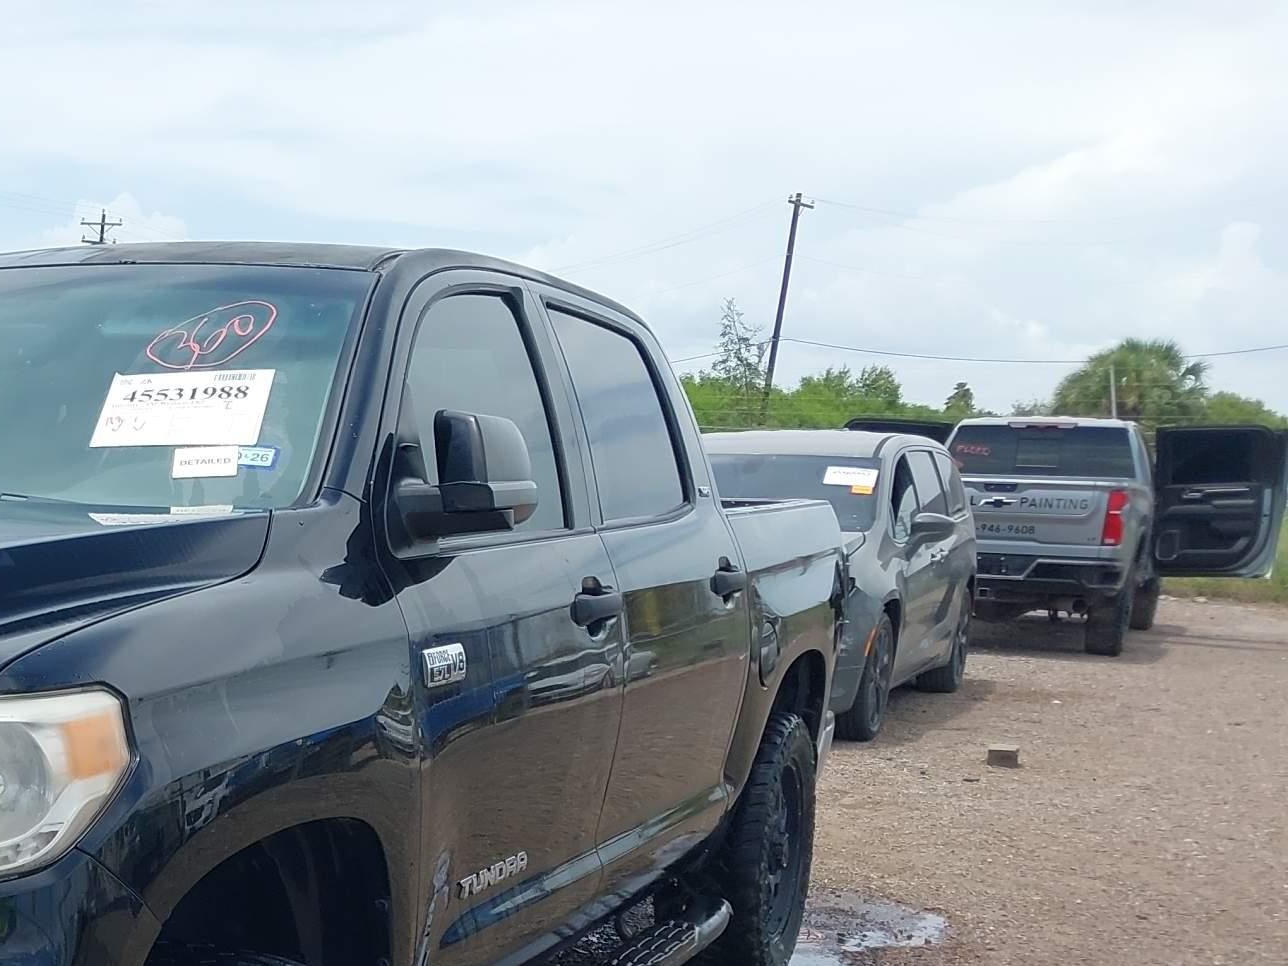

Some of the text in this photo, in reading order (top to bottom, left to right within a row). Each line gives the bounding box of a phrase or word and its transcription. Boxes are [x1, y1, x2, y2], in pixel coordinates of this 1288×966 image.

[122, 385, 250, 403] 45531988
[179, 457, 231, 466] DETAILED
[1019, 496, 1089, 510] PAINTING
[458, 850, 528, 899] TUNDRA
